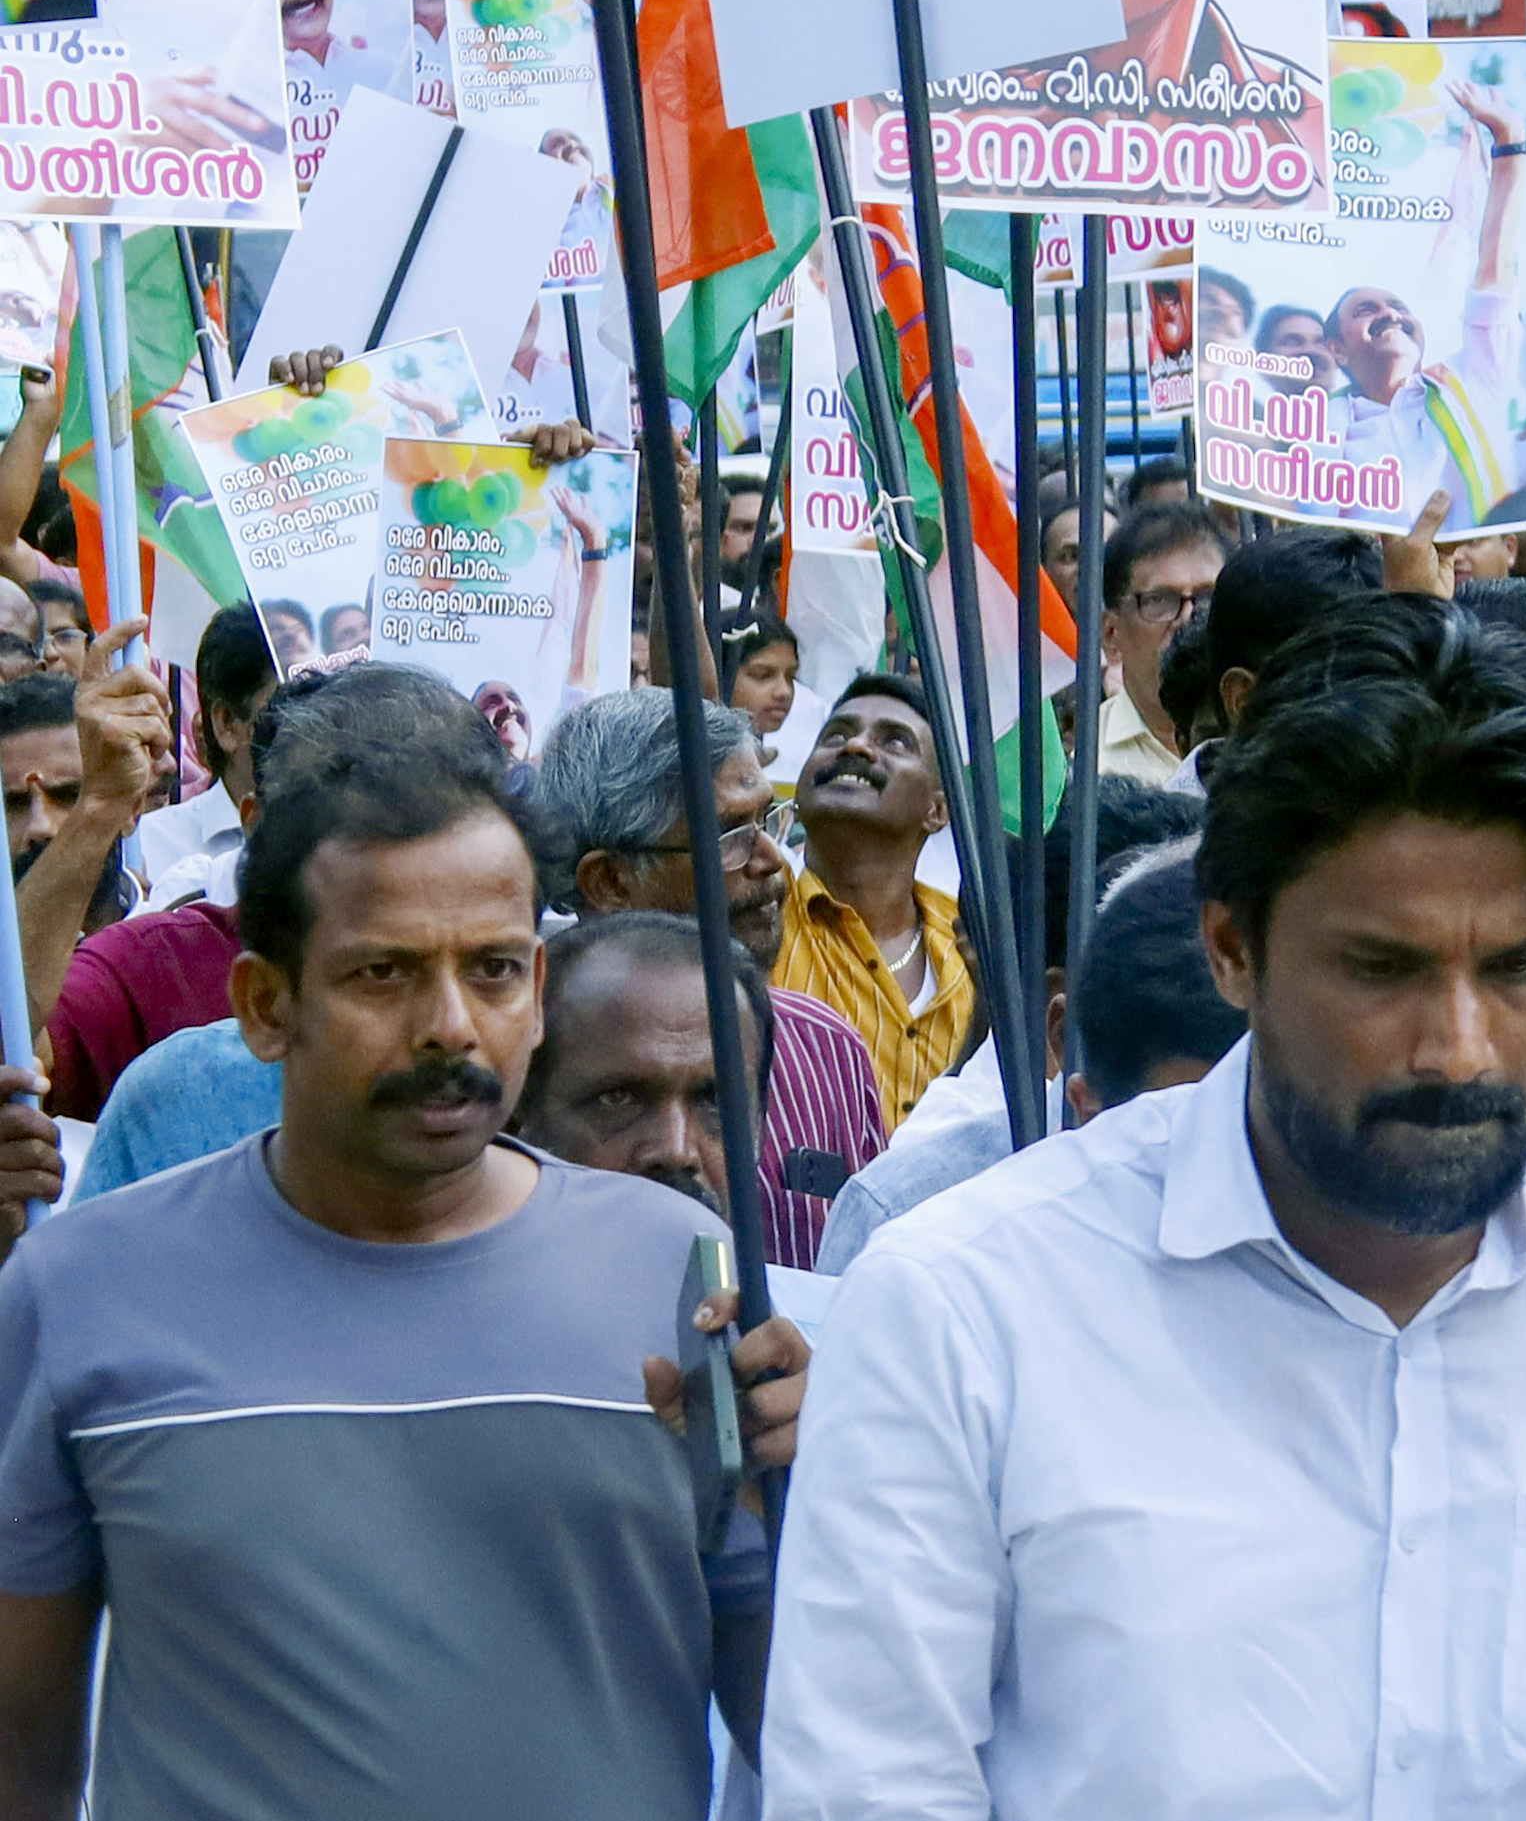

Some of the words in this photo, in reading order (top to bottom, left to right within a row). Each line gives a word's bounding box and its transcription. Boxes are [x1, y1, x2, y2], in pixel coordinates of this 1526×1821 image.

[1046, 57, 1149, 112] വി.ഡി.
[1158, 64, 1302, 114] സതീശൻ
[1207, 380, 1338, 444] വി.ഡി.
[1208, 440, 1401, 511] സതീശൻ
[387, 526, 426, 548] ഒരേ
[430, 525, 505, 557] വികാരം,
[386, 557, 425, 579] ഒരേ
[381, 619, 412, 645] ഒറ്റ
